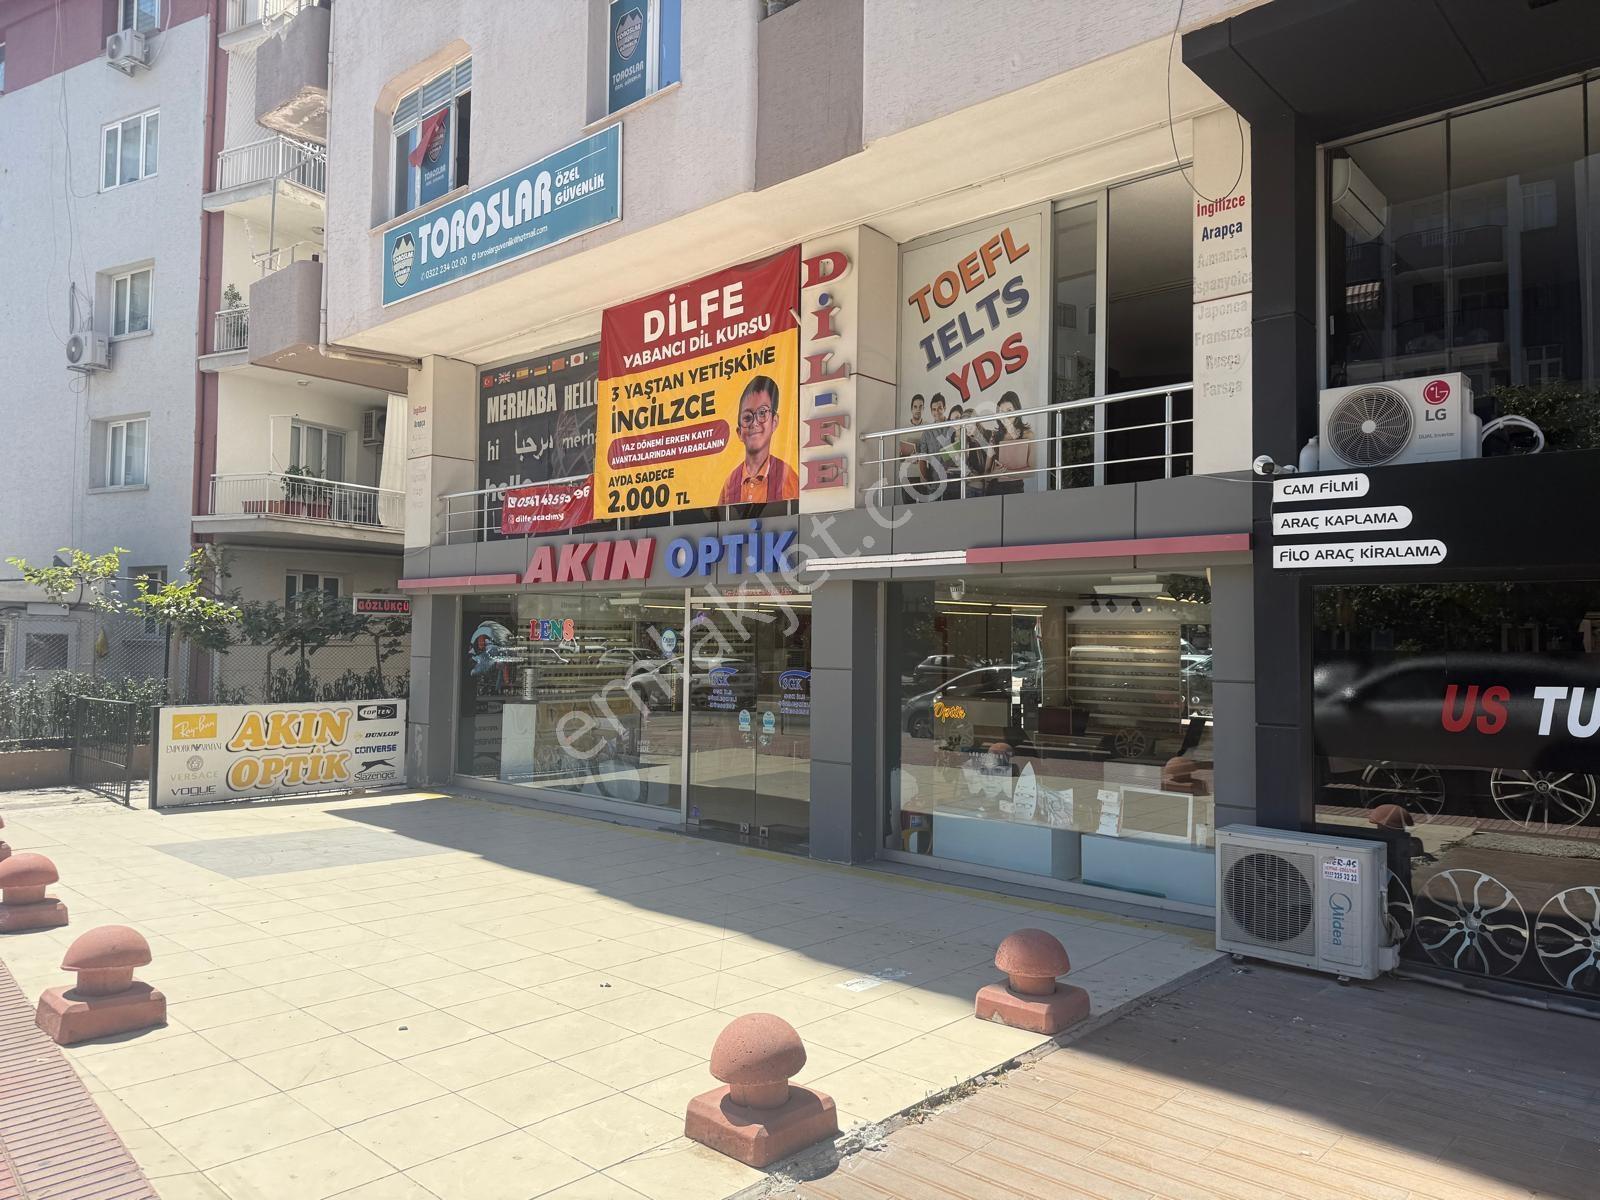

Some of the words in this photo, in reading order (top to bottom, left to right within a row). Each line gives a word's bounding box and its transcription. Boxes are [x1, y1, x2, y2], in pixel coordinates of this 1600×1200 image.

[555, 166, 580, 187] ÖZEL
[555, 172, 605, 206] GÜVENLİK
[418, 170, 552, 264] TOROSLAR
[1196, 194, 1246, 218] İngilizce
[1201, 221, 1243, 242] Arapça
[425, 267, 439, 279] 0322
[439, 264, 450, 275] 234
[451, 260, 459, 270] 02
[460, 256, 468, 266] 00
[908, 227, 1031, 324] TOEFL
[643, 281, 744, 344] DİLFE
[919, 275, 1030, 373] IELTS
[623, 340, 686, 369] YABANCI
[689, 329, 712, 349] DİL
[716, 313, 772, 344] KURSU
[611, 386, 620, 402] 3
[624, 372, 684, 401] YAŞTAN
[688, 346, 776, 385] YETİŞKİNE
[945, 332, 1029, 403] YDS
[487, 383, 557, 424] MERHABA
[611, 390, 716, 434] İNGİLZCE
[1425, 408, 1447, 421] LG
[487, 438, 500, 462] hi
[514, 429, 554, 463] مرحبا
[562, 428, 596, 449] merh
[621, 442, 636, 452] YAZ
[636, 436, 664, 450] DÖNEMİ
[665, 434, 690, 445] ERKEN
[691, 429, 714, 440] KAYIT
[611, 448, 676, 466] AVANTAJLARINDAN
[678, 439, 725, 455] YARARLANIN
[608, 474, 634, 488] AYDA
[635, 468, 675, 483] SADECE
[1283, 482, 1314, 496] CAM
[1319, 476, 1359, 493] FİLMİ
[608, 483, 670, 513] 2.000
[675, 491, 691, 505] TL
[1280, 515, 1320, 530] ARAÇ
[1325, 511, 1398, 527] KAPLAMA
[522, 537, 656, 584] AKIN
[664, 519, 798, 579] OPTİK
[1279, 547, 1310, 562] FİLO
[1314, 547, 1354, 562] ARAÇ
[1360, 544, 1441, 560] KİRALAMA
[357, 600, 409, 612] GÖZLÜKÇÜ
[529, 618, 575, 641] LENS
[1441, 684, 1511, 735] US
[174, 714, 215, 738] Ray-Ban
[227, 708, 352, 752] AKIN
[364, 730, 400, 739] DUNLOP
[354, 744, 397, 754] CONVERSE
[170, 770, 219, 781] VERSACE
[227, 746, 352, 791] OPTİK
[1330, 895, 1349, 946] Midea
